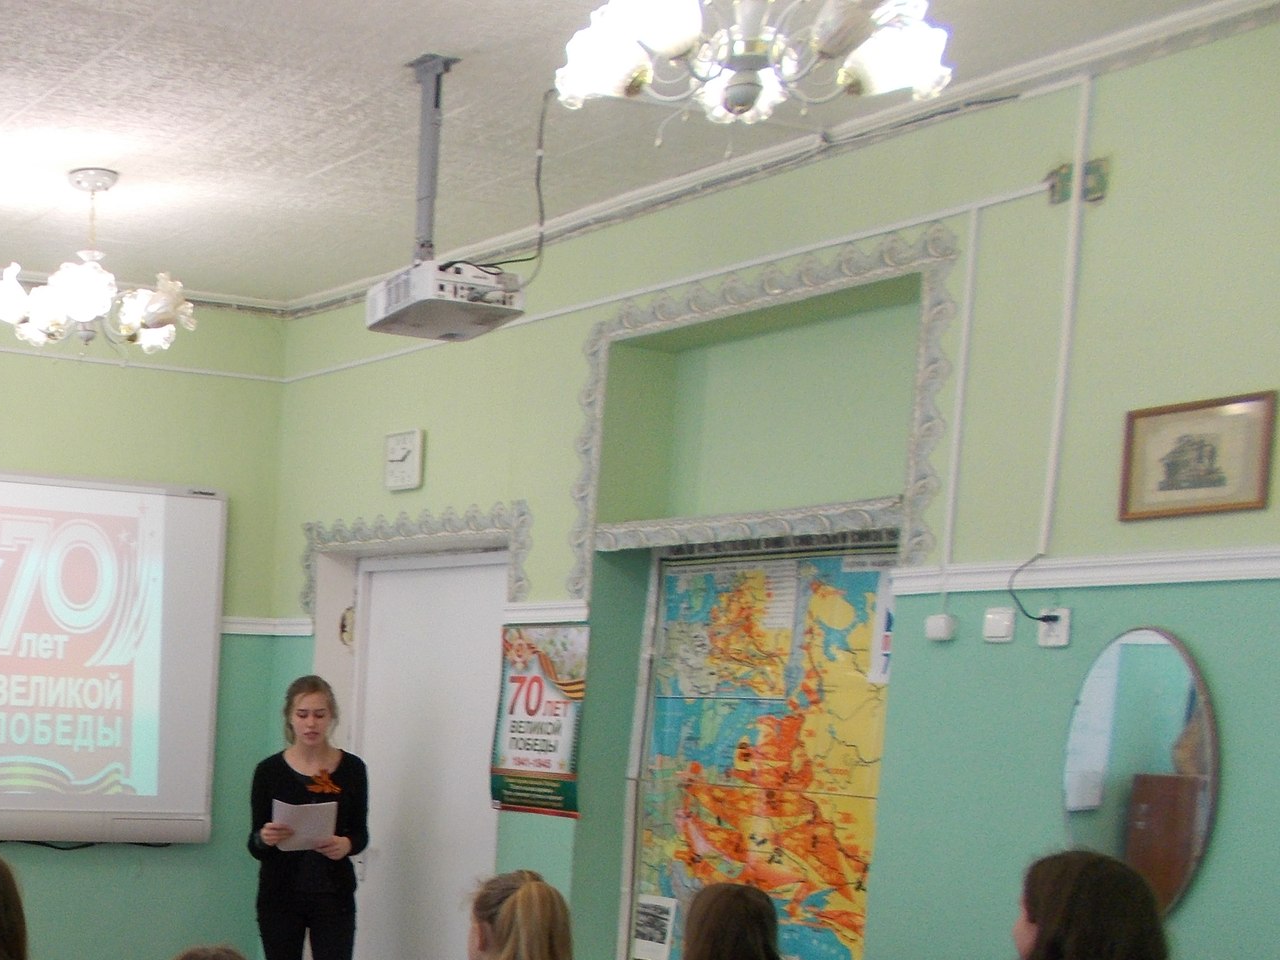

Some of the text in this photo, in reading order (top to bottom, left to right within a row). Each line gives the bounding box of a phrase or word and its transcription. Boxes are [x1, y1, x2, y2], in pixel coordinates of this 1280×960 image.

[19, 631, 70, 660] лет
[508, 676, 570, 717] 70 ЛЕТ
[510, 720, 562, 735] ВЕЛИКОЙ
[509, 737, 557, 753] ПОБЕДЫ
